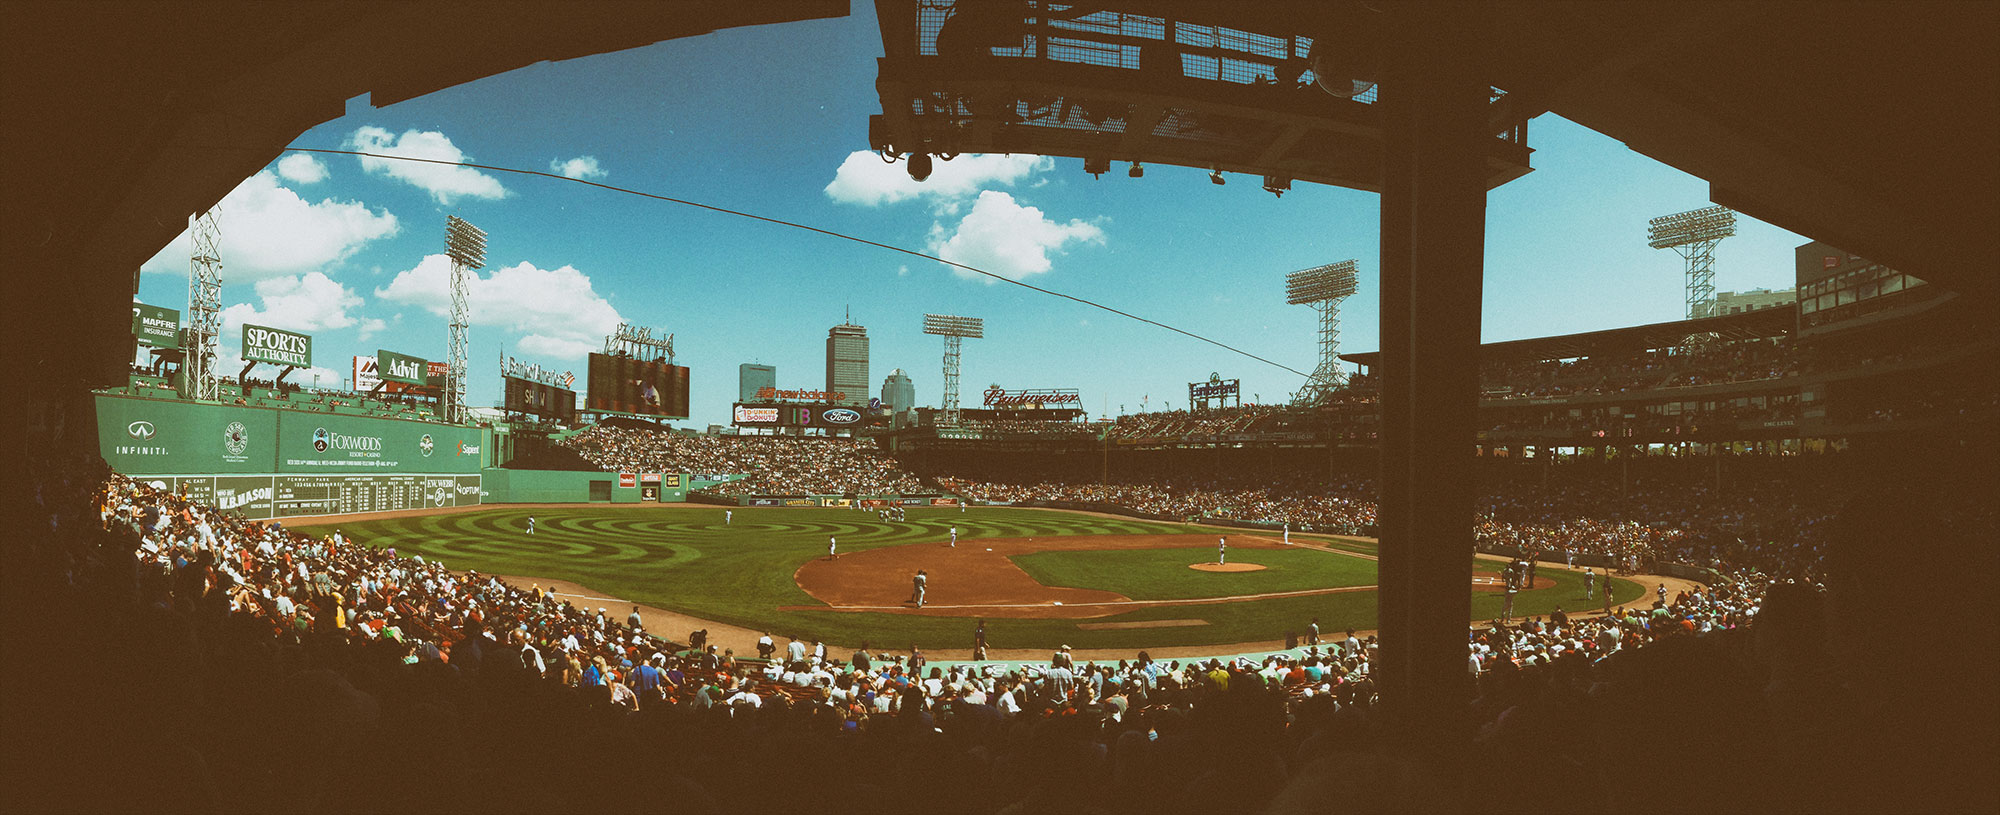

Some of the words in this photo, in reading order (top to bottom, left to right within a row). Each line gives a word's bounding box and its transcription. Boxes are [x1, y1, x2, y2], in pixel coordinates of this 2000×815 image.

[142, 317, 176, 329] MAPFRE
[143, 327, 175, 338] INSURANCE
[247, 328, 307, 354] SPORTS
[387, 358, 420, 380] Advil
[776, 390, 800, 399] new
[800, 388, 845, 400] balance
[983, 389, 1078, 406] Budweiser
[830, 411, 853, 422] Ford
[462, 486, 480, 495] OPTUM
